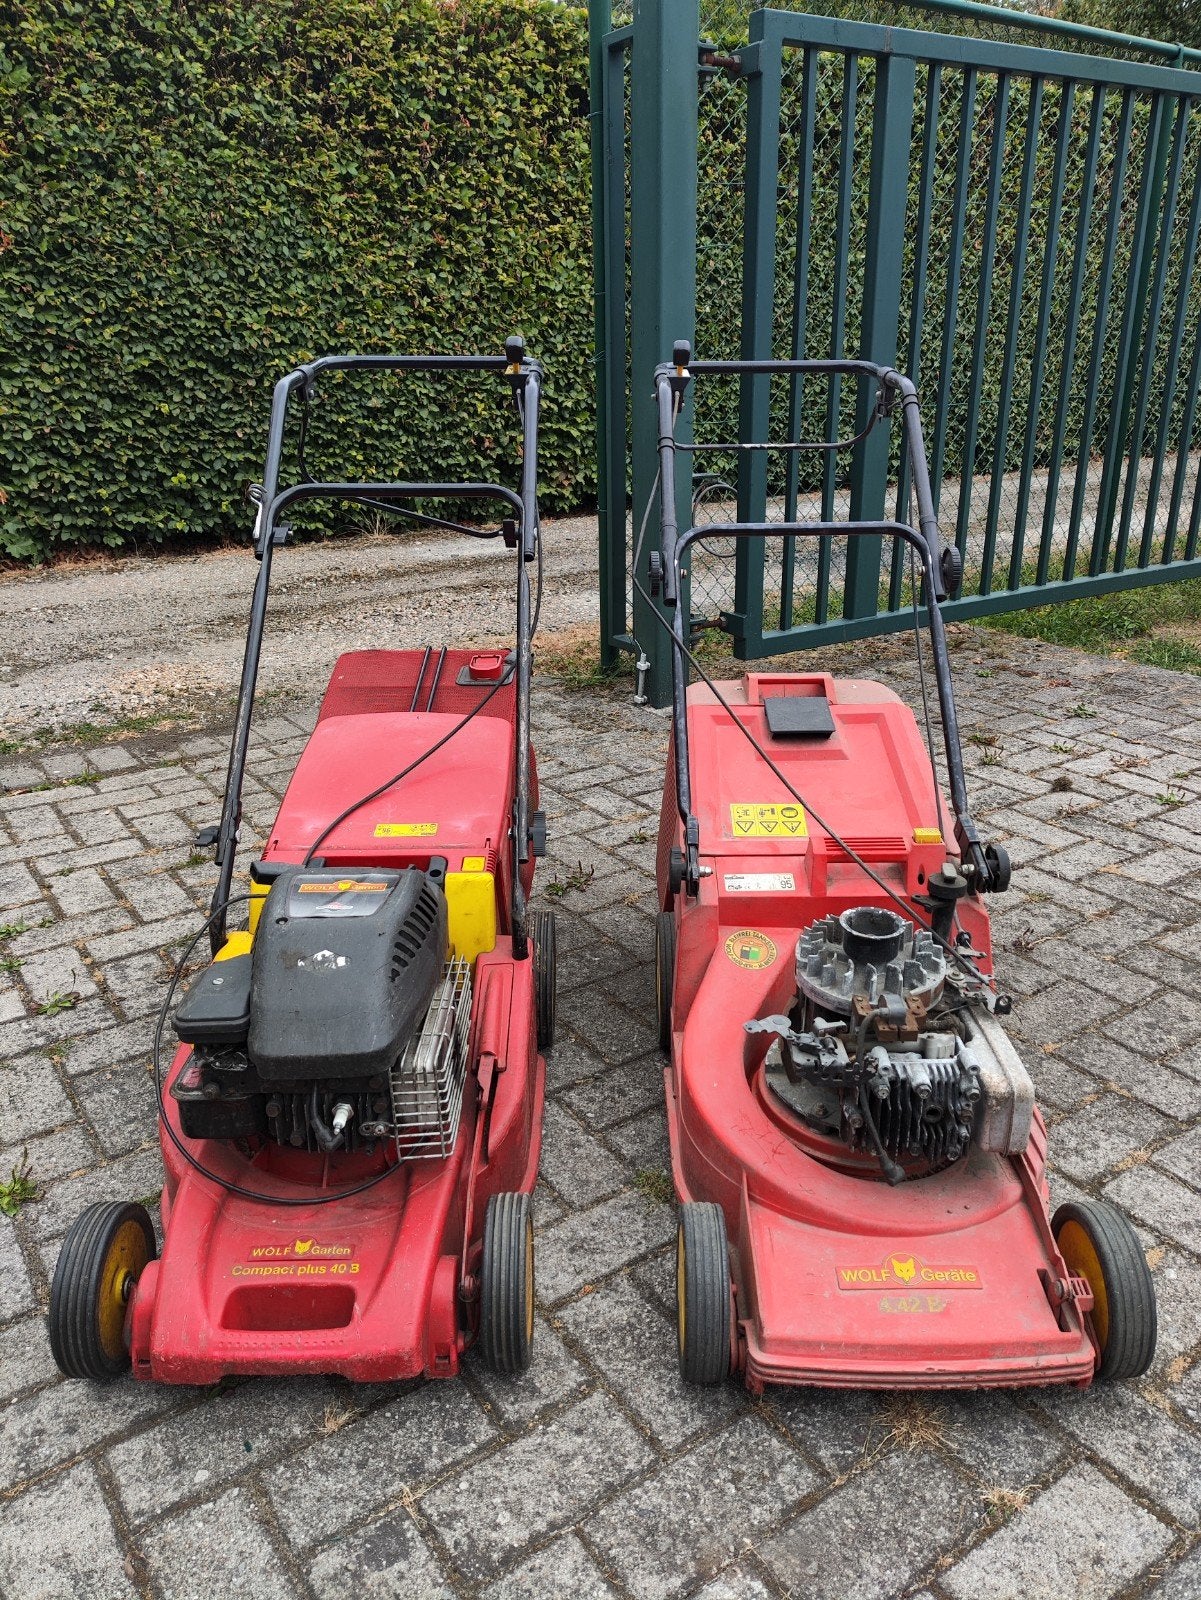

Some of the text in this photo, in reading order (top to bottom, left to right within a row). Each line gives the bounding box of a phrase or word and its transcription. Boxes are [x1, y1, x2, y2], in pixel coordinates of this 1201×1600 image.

[780, 880, 793, 889] 95
[252, 1245, 351, 1257] WOLF Garten
[231, 1263, 360, 1276] Compact plus 40 B
[841, 1267, 977, 1282] WOLF Geräte
